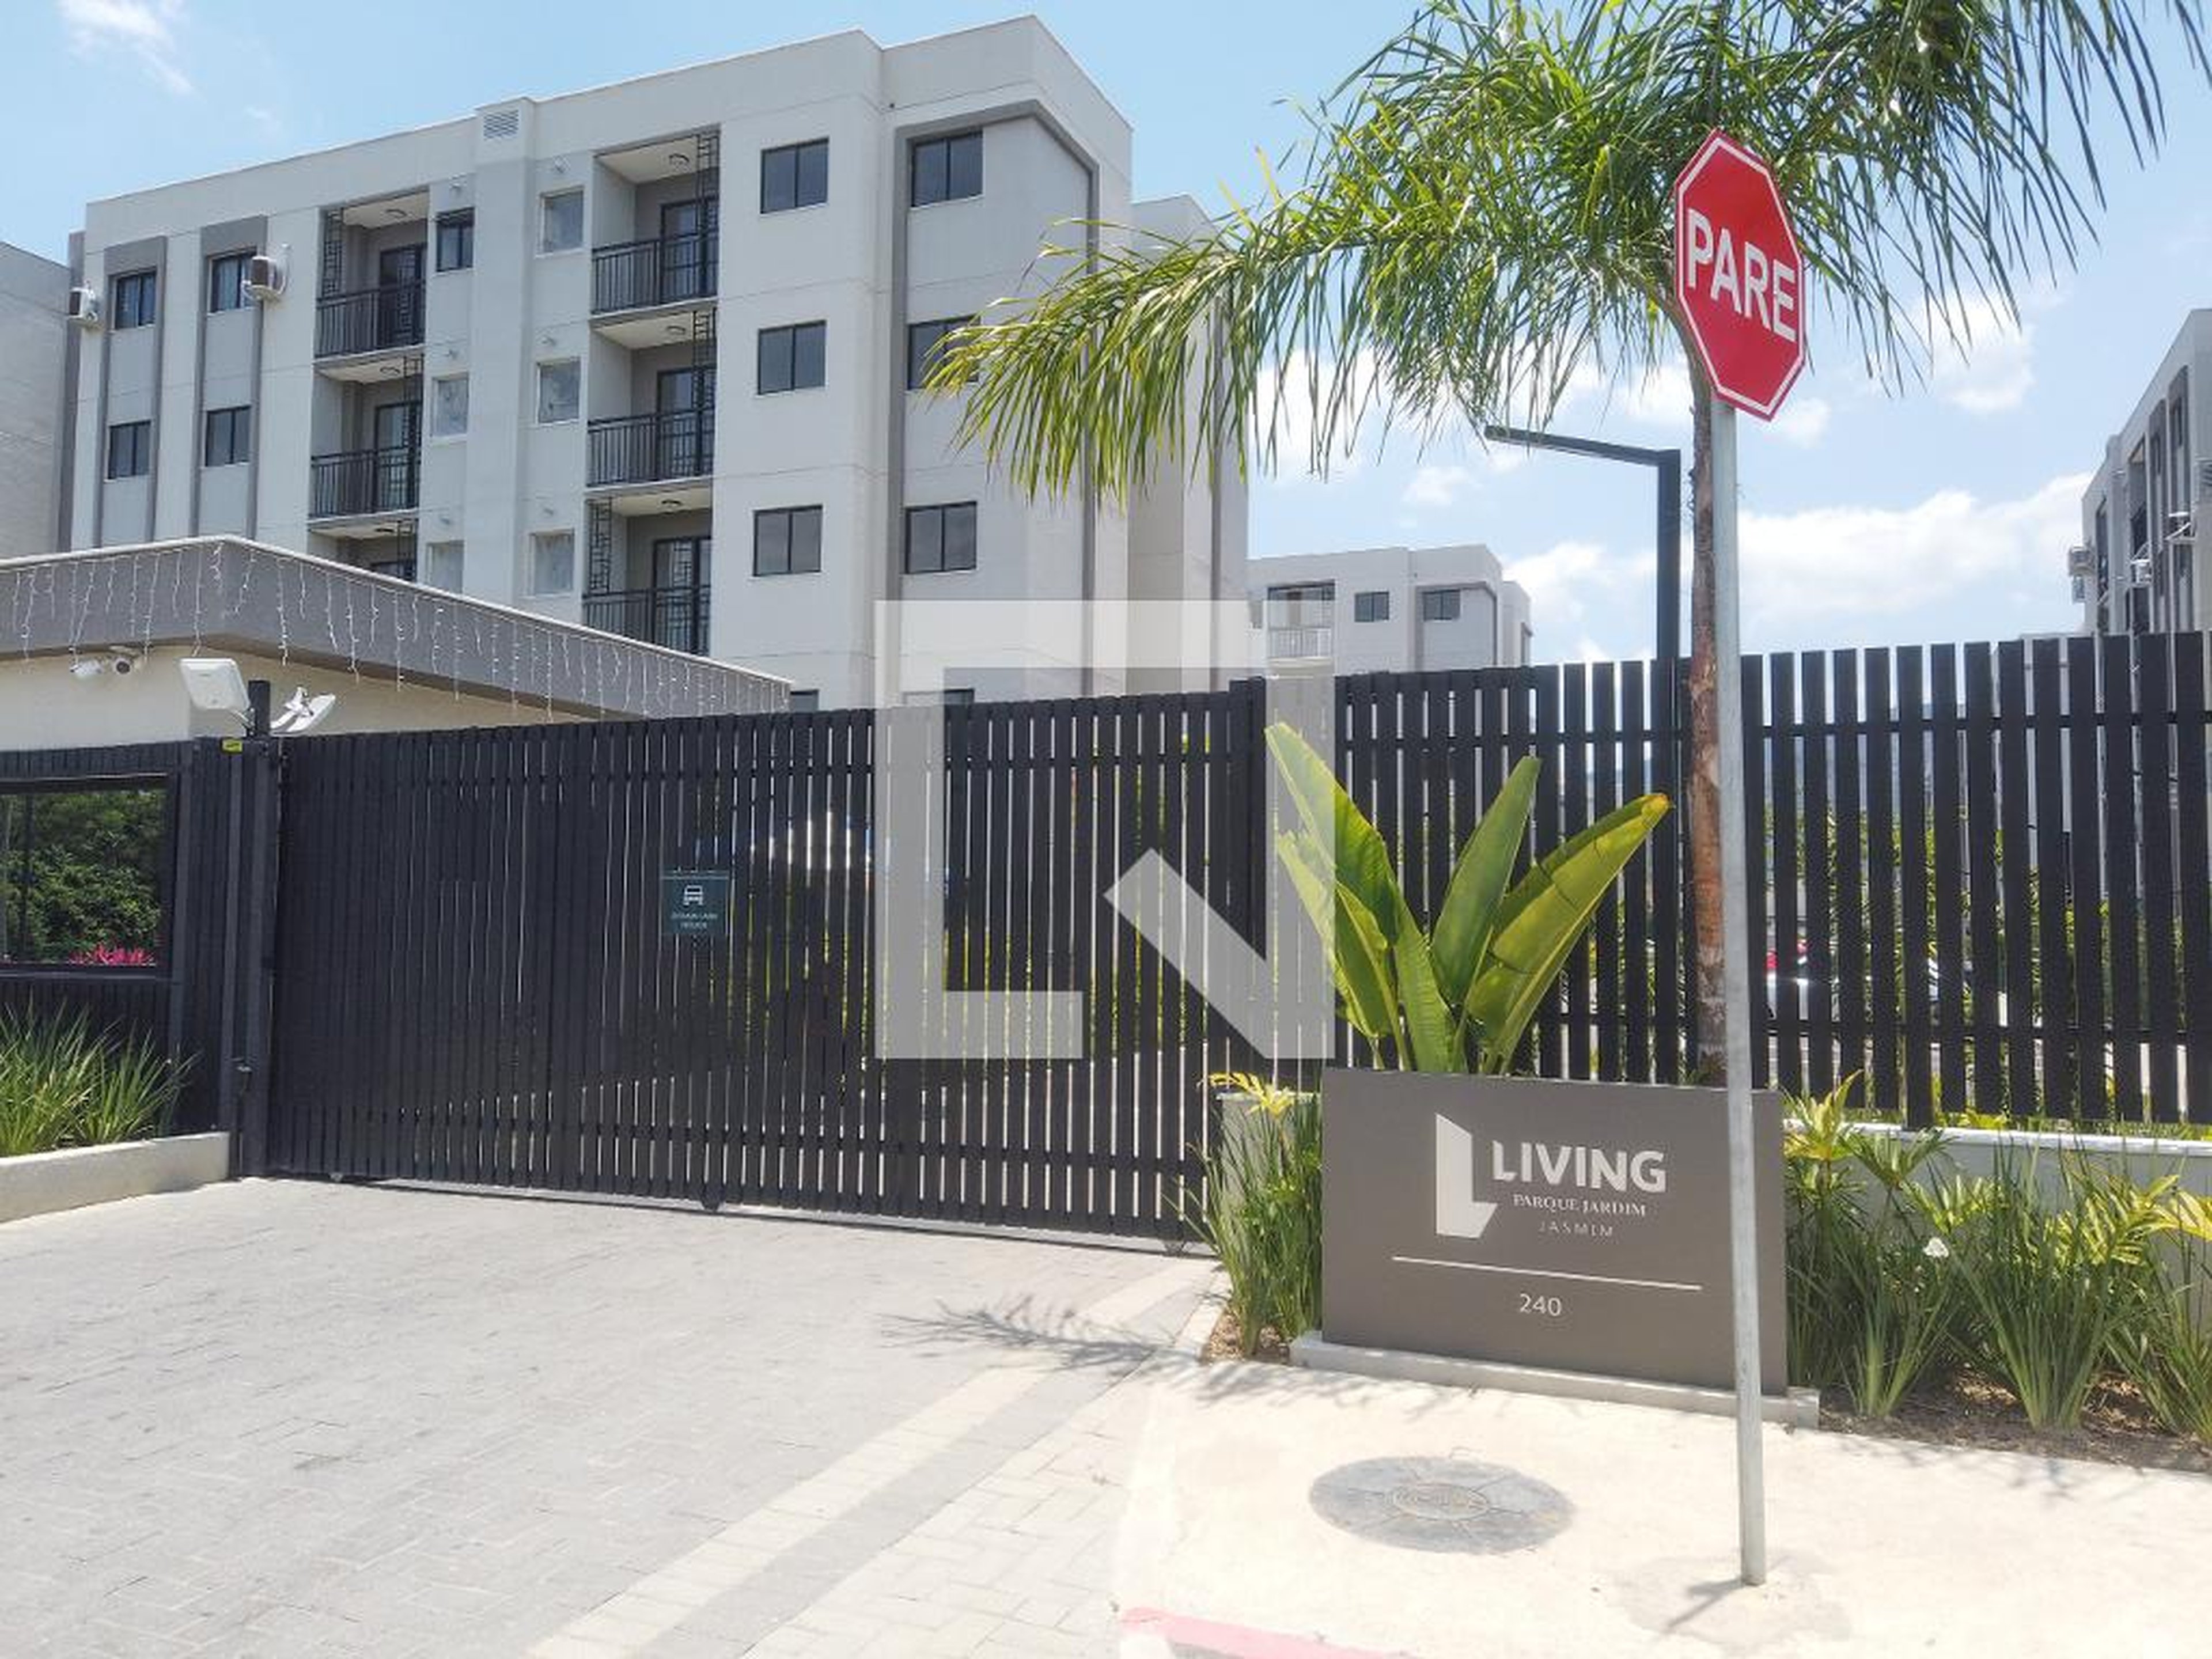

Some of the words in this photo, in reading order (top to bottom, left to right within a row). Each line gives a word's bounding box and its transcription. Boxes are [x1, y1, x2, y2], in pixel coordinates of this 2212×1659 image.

[1687, 208, 1797, 343] PARE
[1492, 1140, 1666, 1193] LIVING
[1513, 1194, 1580, 1213] PARQUE
[1582, 1199, 1646, 1217] JARDIM
[1519, 1292, 1562, 1316] 240
